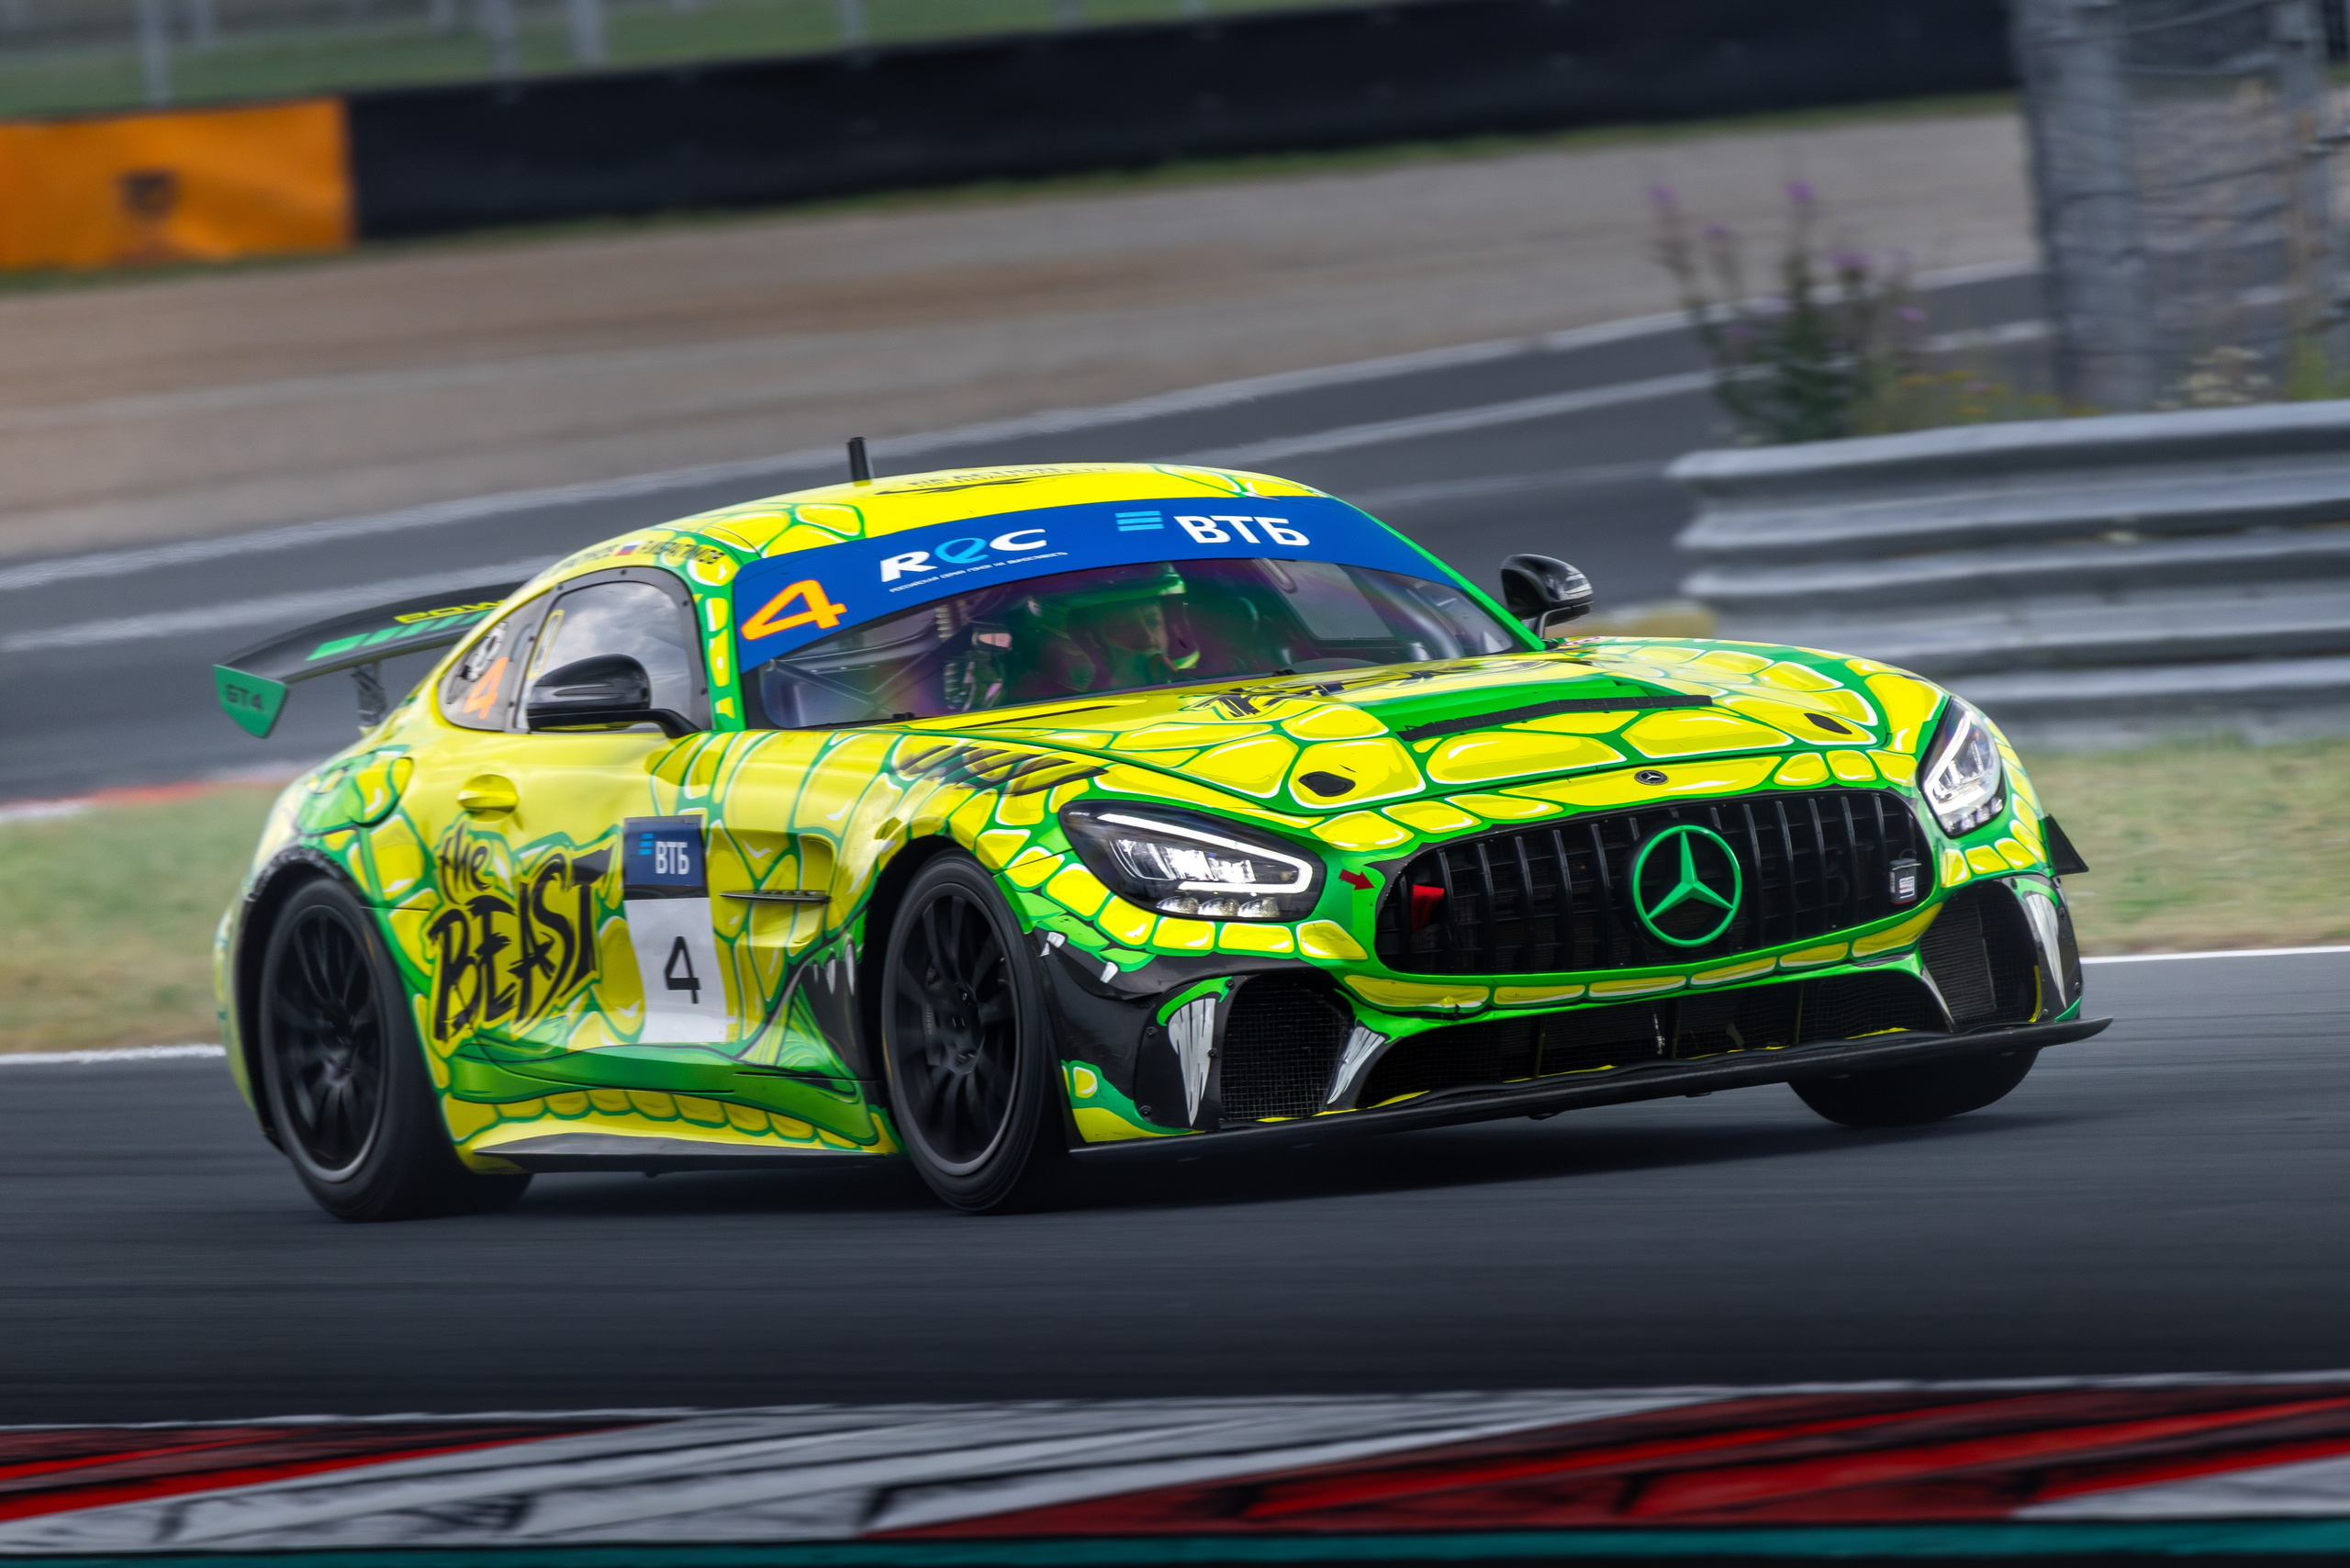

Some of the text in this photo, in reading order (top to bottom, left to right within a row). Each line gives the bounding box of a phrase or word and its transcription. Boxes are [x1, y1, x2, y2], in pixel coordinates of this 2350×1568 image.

[1173, 515, 1311, 546] ВТБ
[741, 579, 847, 641] 4
[464, 655, 509, 720] 4
[655, 841, 690, 875] ВТБ
[426, 843, 615, 1045] BEAST
[664, 935, 701, 1004] 4
